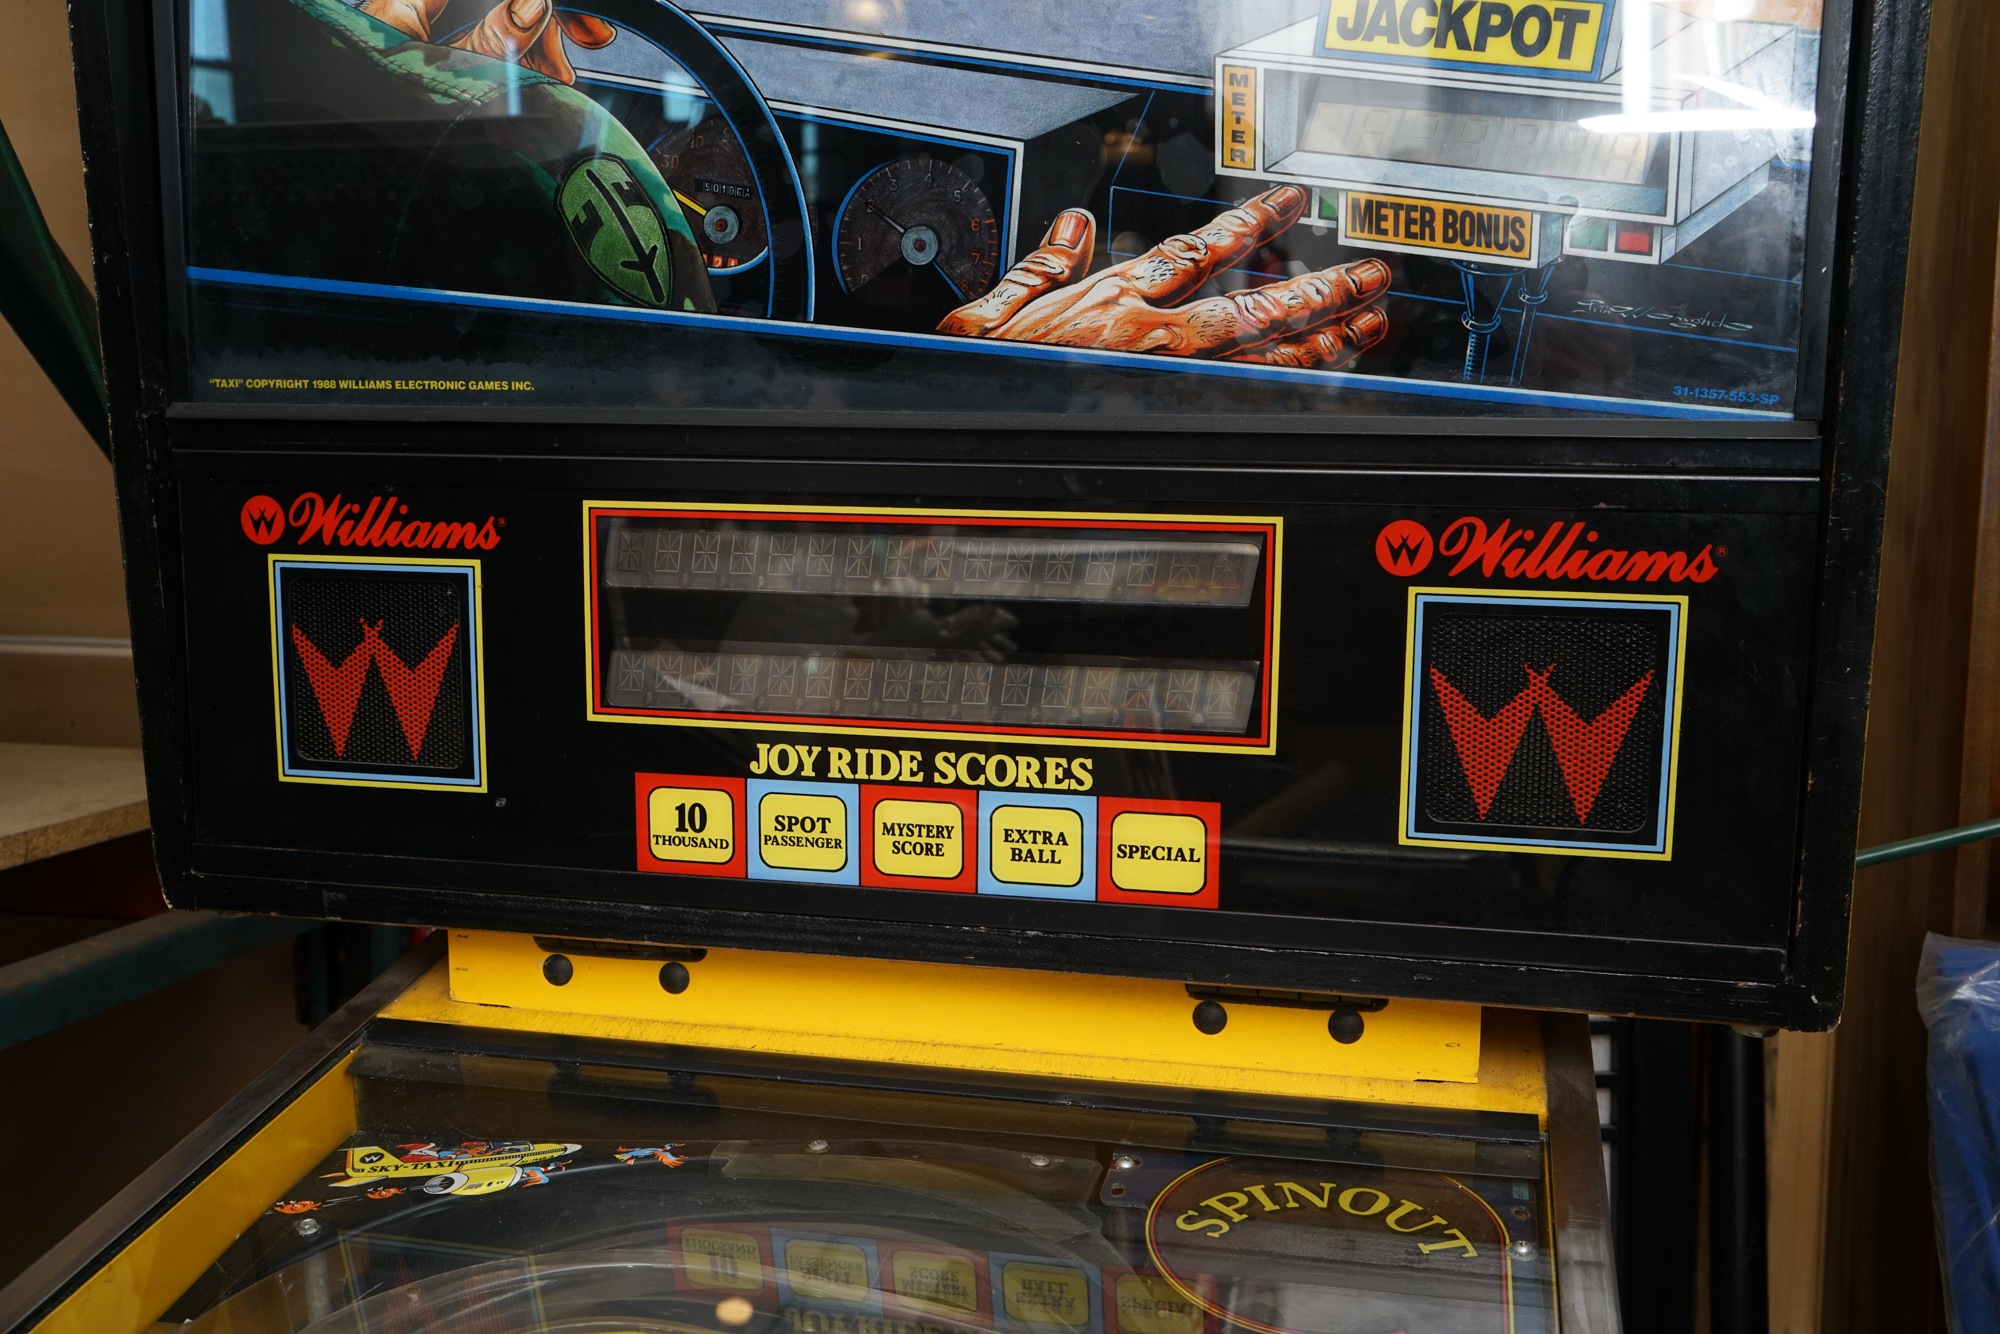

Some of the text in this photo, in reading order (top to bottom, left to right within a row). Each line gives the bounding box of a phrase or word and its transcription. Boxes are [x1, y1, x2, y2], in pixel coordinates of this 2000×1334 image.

[1336, 0, 1590, 61] JACKPOT
[1229, 72, 1248, 164] METER
[889, 179, 898, 191] 3
[954, 190, 962, 202] 5
[971, 218, 980, 232] 6
[1350, 193, 1526, 253] METER BONUS
[971, 252, 981, 265] 7
[961, 279, 969, 293] 8
[245, 379, 309, 389] COPYRIGHT
[312, 380, 337, 389] 1988
[338, 379, 392, 389] WILLIAMS
[395, 380, 466, 390] ELECTRONIC
[468, 380, 508, 390] GAMES
[511, 381, 535, 391] INC.
[1673, 386, 1780, 405] 31-1357-553-SP
[750, 743, 1093, 791] JOY RIDE SCORES
[675, 802, 707, 833] 10
[774, 814, 831, 834] SPOT
[882, 822, 955, 840] MYSTERY
[1003, 828, 1069, 846] EXTRA
[653, 834, 729, 849] THOUSAND
[763, 835, 843, 849] PASSENGER
[891, 840, 945, 857] SCORE
[1010, 847, 1062, 865] BALL
[1116, 843, 1201, 863] SPECIAL
[367, 1160, 454, 1174] SKY-TAXI
[1175, 1182, 1477, 1260] SPINOUT
